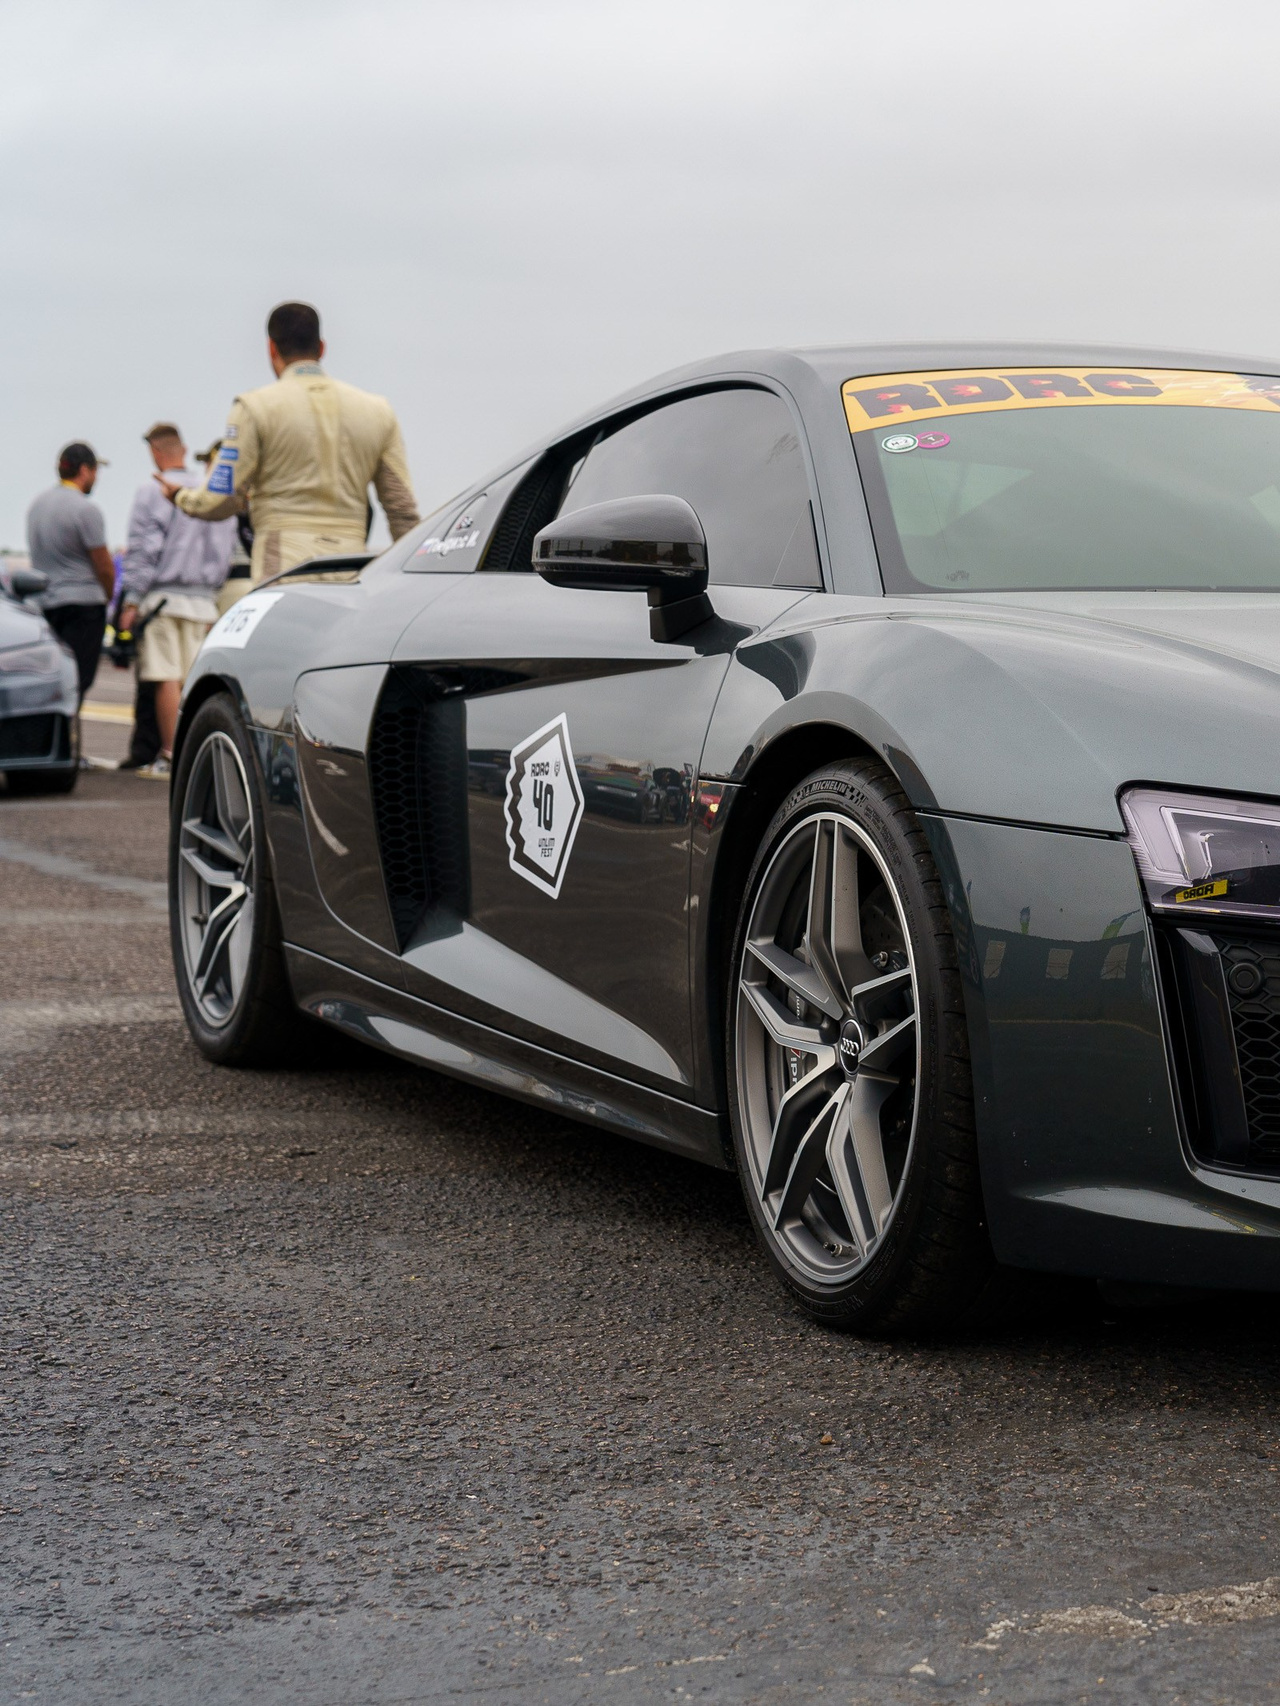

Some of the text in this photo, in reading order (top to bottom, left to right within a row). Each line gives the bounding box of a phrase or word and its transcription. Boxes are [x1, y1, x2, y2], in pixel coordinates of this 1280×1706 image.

[846, 374, 1165, 419] RDRC
[811, 780, 849, 794] MICHELIN
[533, 779, 554, 832] 40
[540, 848, 554, 858] FEST
